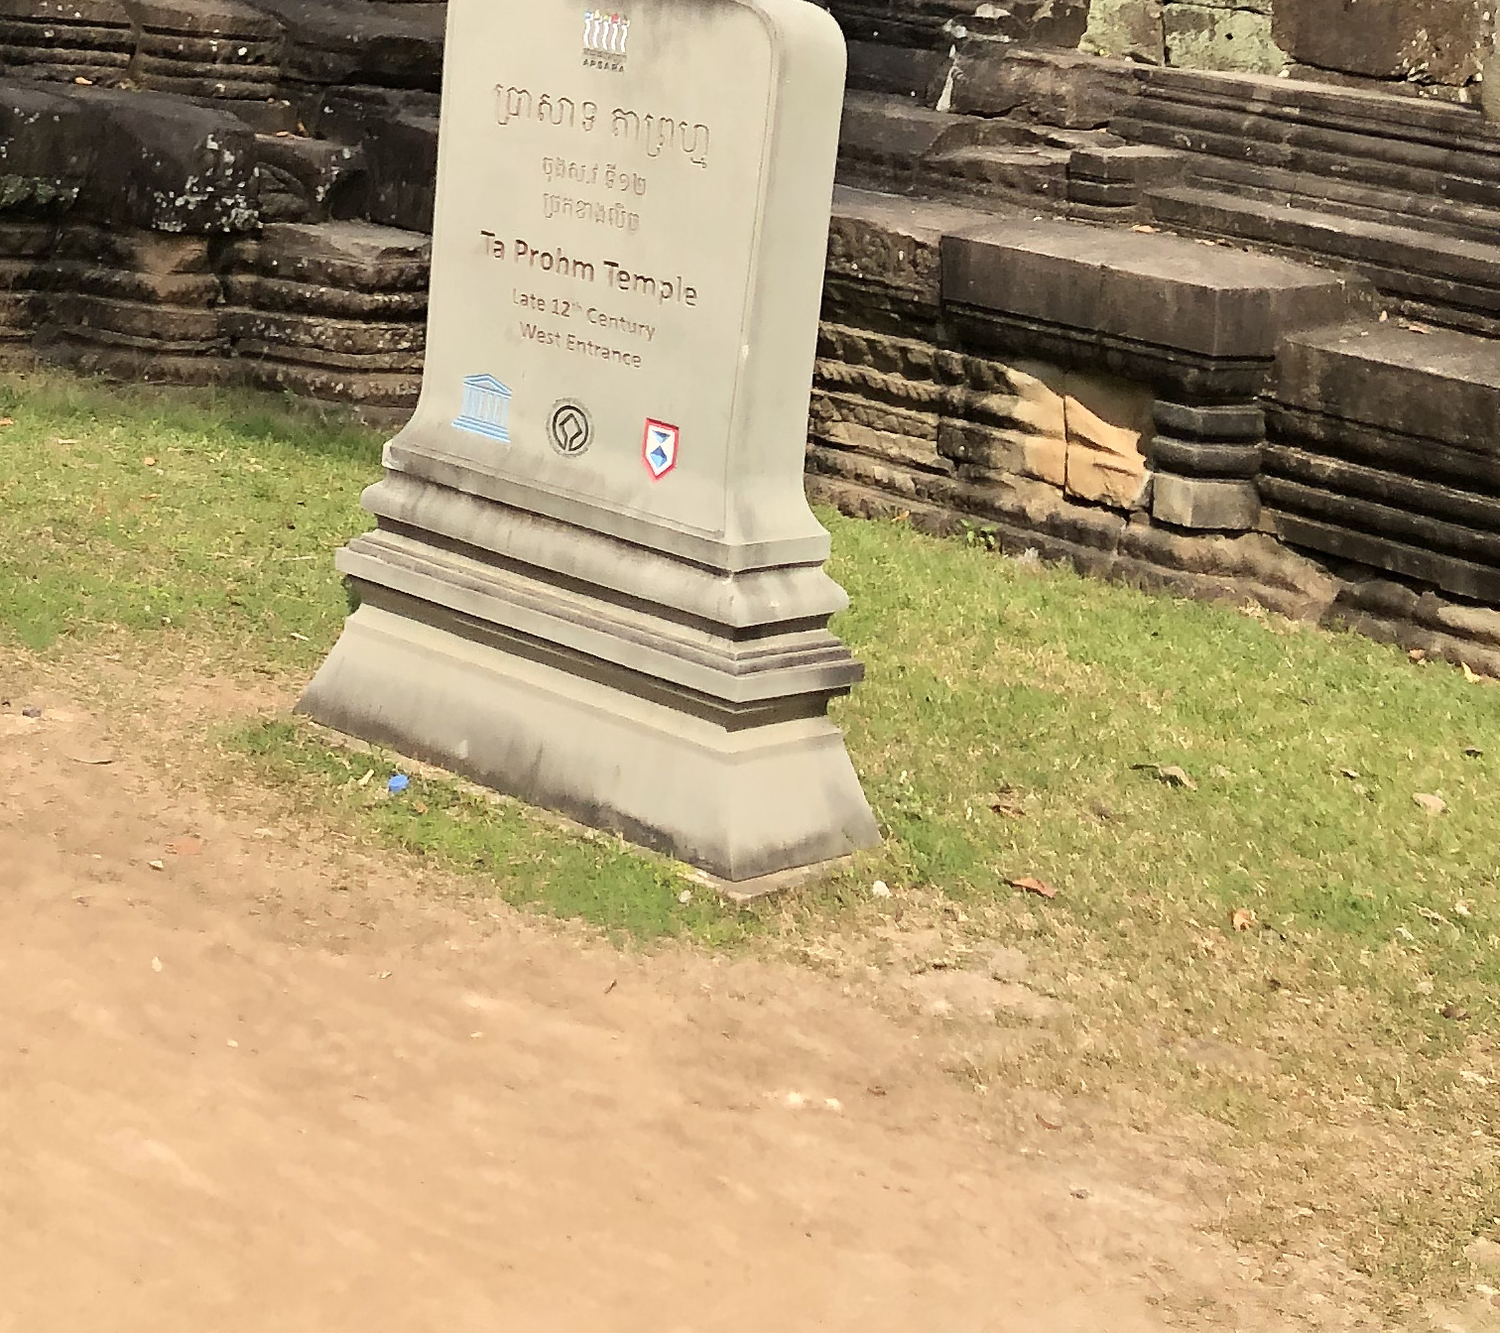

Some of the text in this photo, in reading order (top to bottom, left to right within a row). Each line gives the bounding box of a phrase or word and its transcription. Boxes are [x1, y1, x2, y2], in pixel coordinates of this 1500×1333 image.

[493, 83, 598, 132] ប្រាសាទ
[480, 230, 698, 306] Ta Prohm Temple
[512, 288, 546, 312] Late
[586, 307, 656, 342] Century
[519, 321, 642, 368] West Entrance
